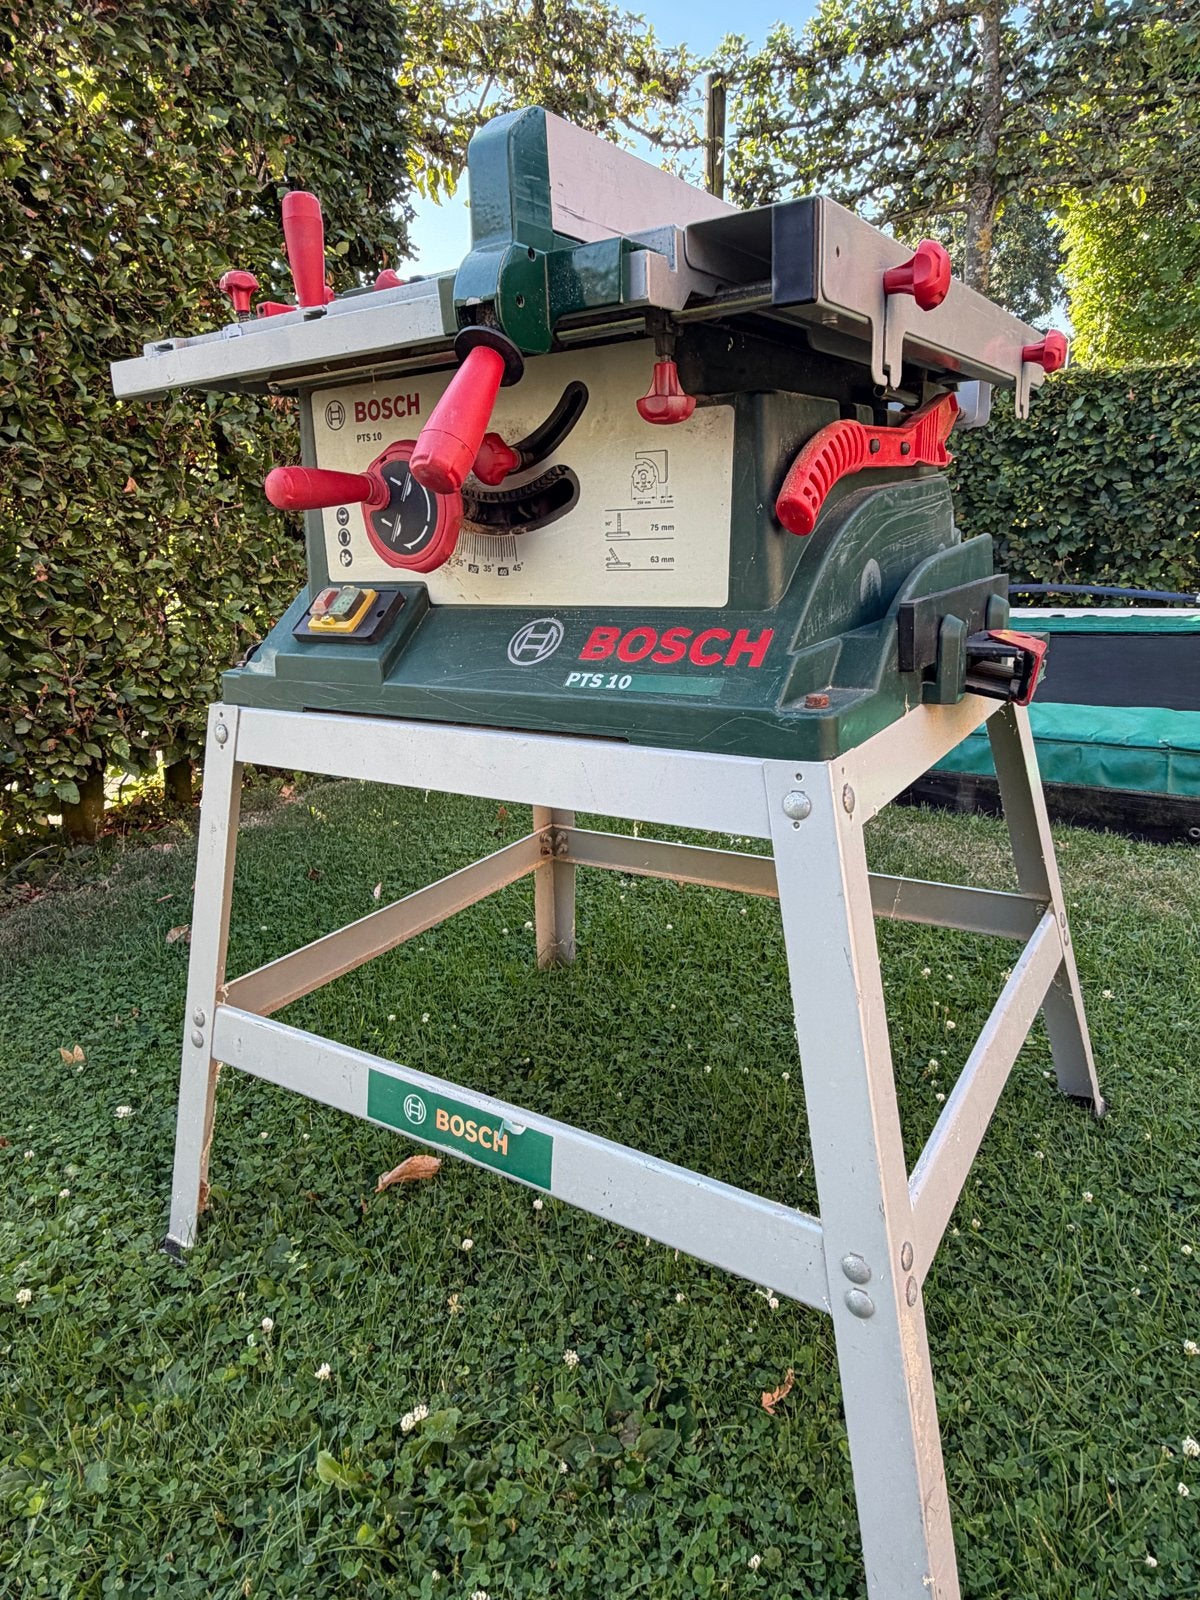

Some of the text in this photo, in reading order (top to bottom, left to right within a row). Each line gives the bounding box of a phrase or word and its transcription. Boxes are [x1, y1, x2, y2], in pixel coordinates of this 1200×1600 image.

[354, 393, 420, 423] BOSCH
[356, 432, 382, 443] PTS 10
[578, 626, 775, 668] BOSCH
[564, 672, 632, 690] PTS 10
[435, 1108, 509, 1156] BOSCH
